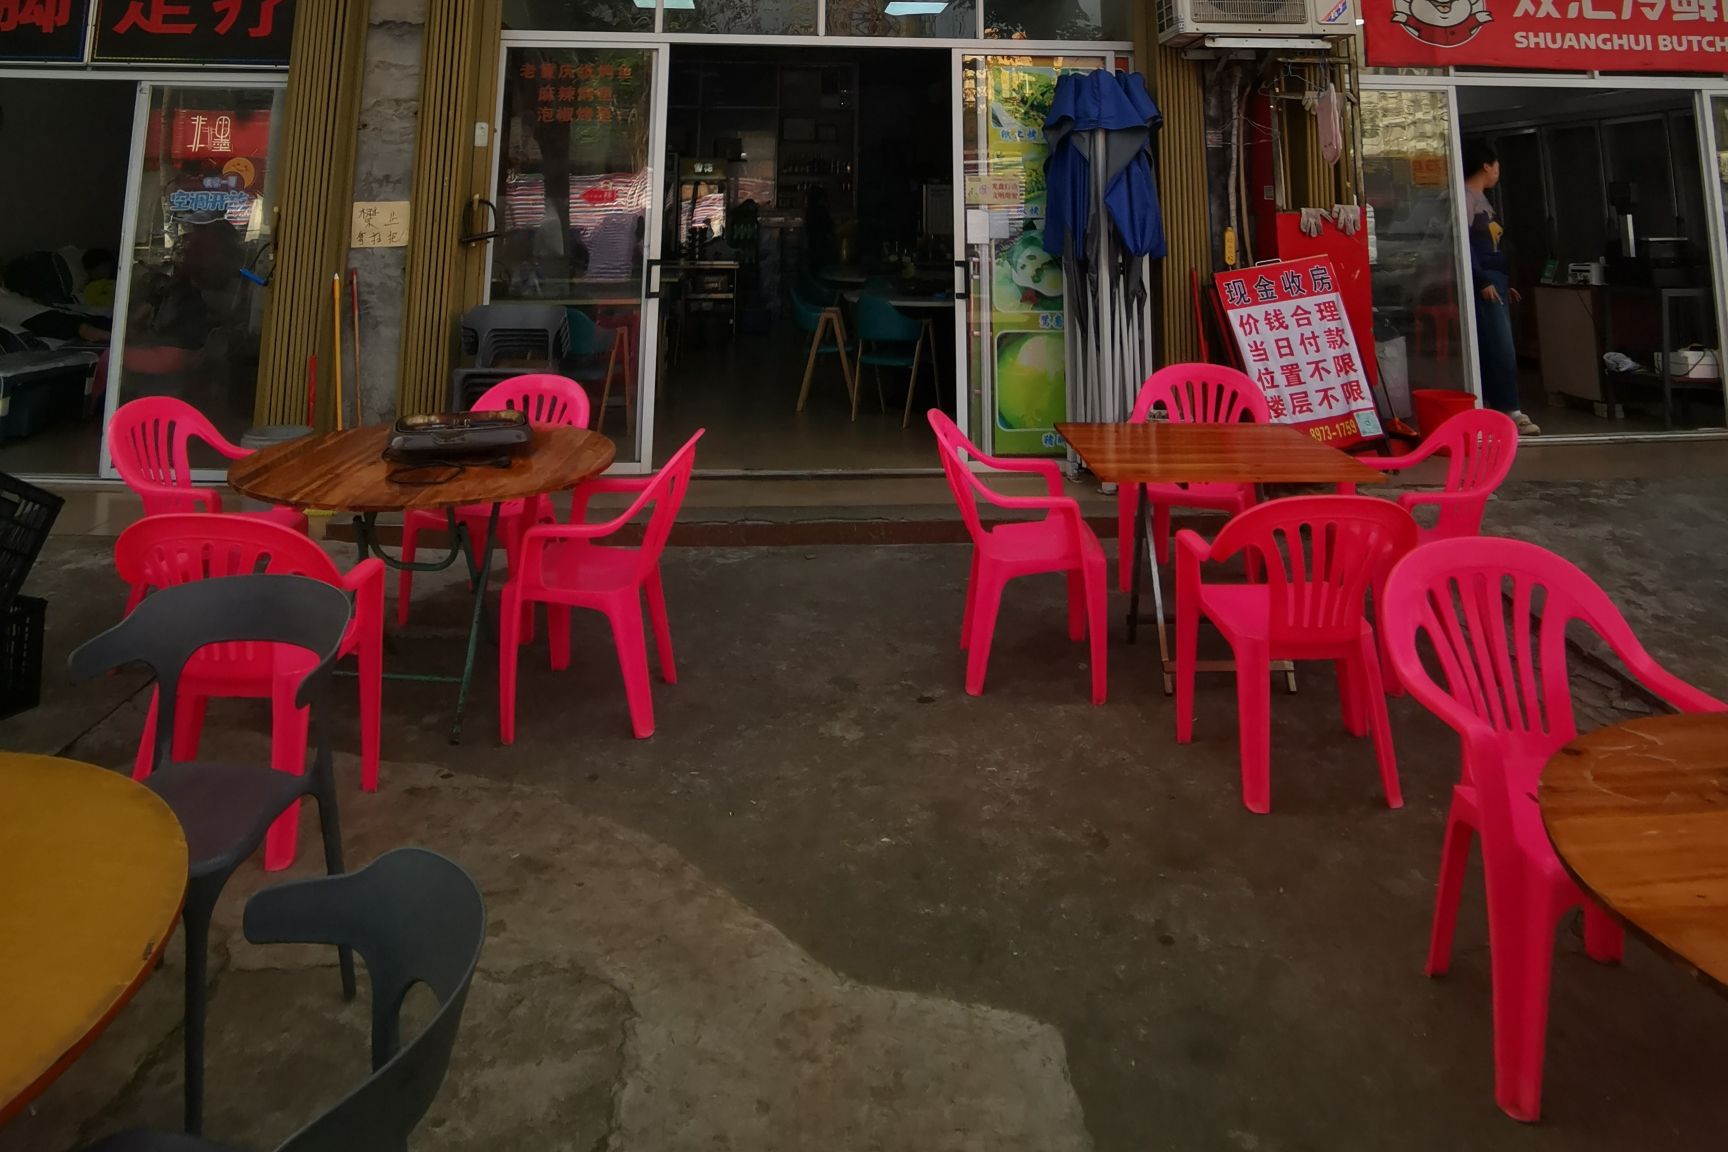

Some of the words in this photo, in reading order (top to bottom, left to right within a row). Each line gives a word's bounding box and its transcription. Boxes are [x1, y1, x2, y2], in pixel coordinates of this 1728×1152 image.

[1514, 31, 1653, 51] SHUANGHUI
[1224, 265, 1332, 306] 现金收房
[1238, 300, 1342, 337] 价钱合理
[1247, 327, 1350, 363] 当日付款
[1256, 354, 1358, 392] 位置不限
